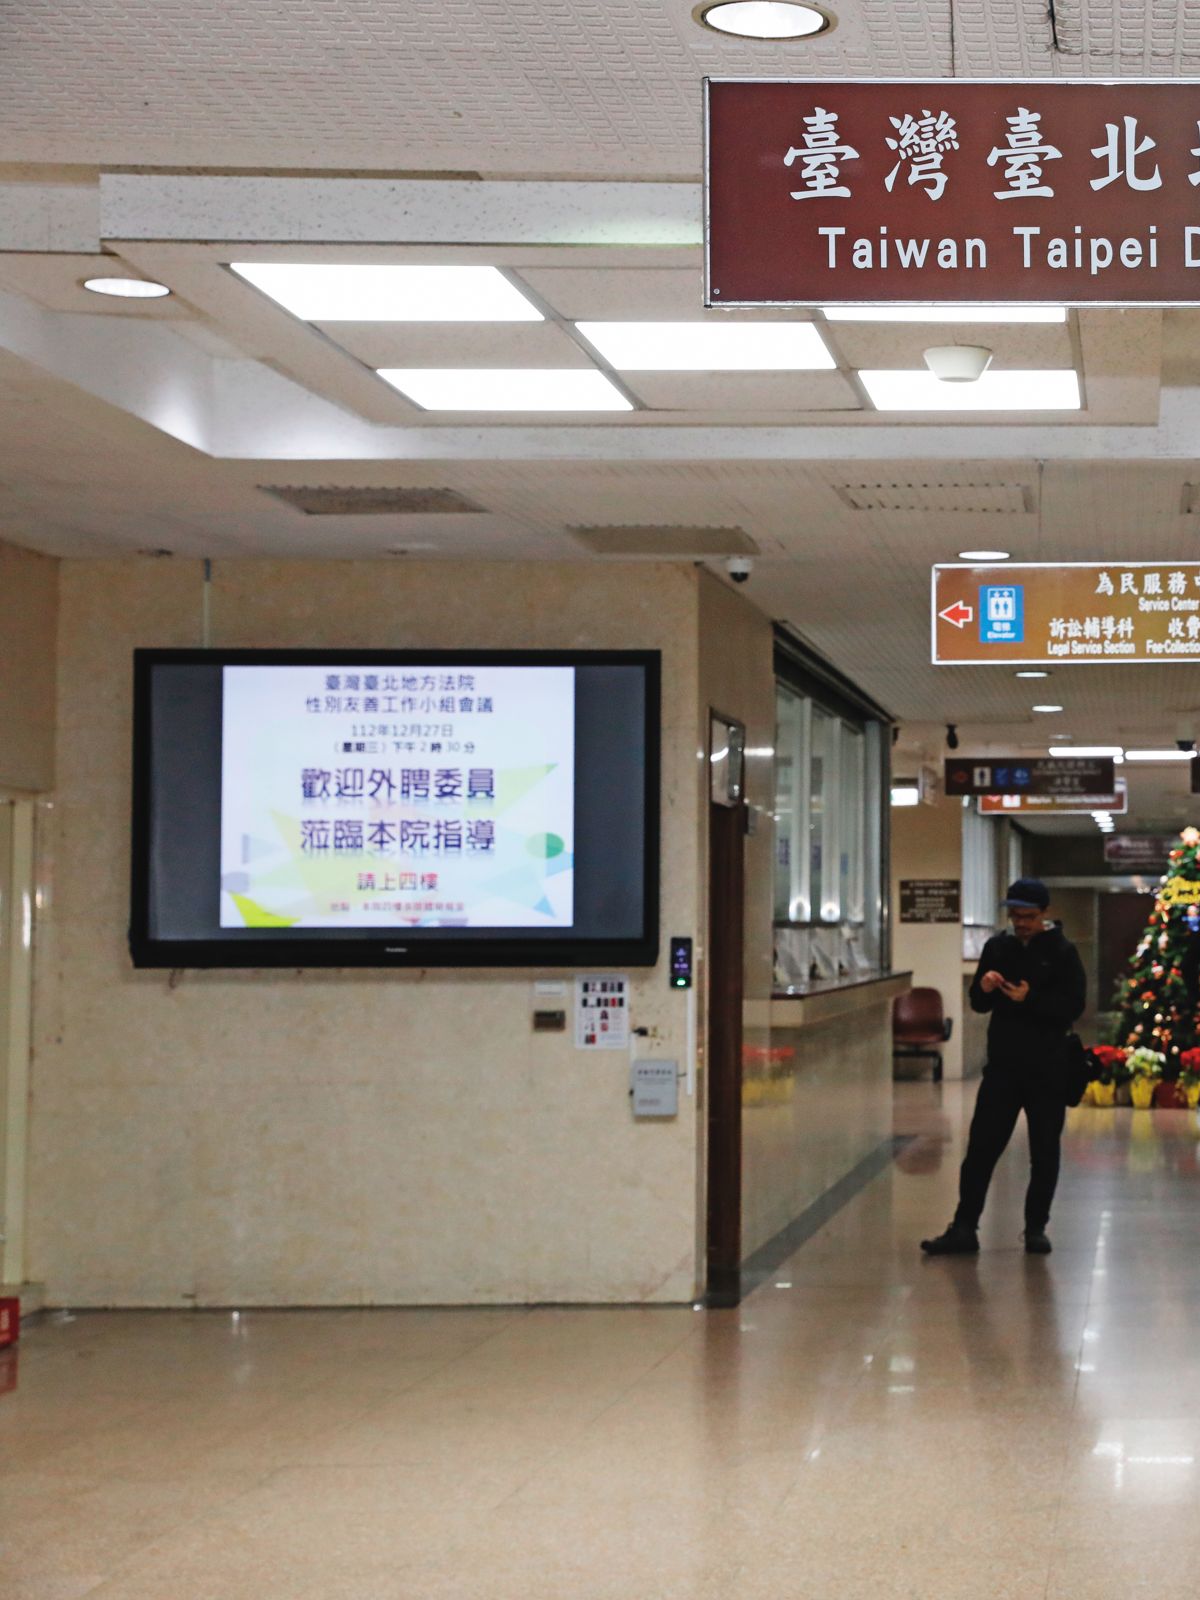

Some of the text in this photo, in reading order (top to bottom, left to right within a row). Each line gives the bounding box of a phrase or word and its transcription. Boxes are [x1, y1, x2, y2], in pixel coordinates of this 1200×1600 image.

[818, 226, 987, 269] Taiwan
[1013, 226, 1157, 275] Taipei
[1138, 597, 1200, 612] Service Center
[1048, 616, 1135, 638] 訴訟輔導科
[1047, 639, 1135, 656] Legal Service Section
[325, 673, 475, 692] 臺灣臺北地方法院
[305, 695, 494, 714] 性別友善工作小組會議
[352, 724, 454, 738] 112年12月27日
[301, 768, 496, 799] 歡迎外聘委員
[300, 820, 496, 851] 蒞臨本院指導
[357, 872, 439, 892] 請上四樓
